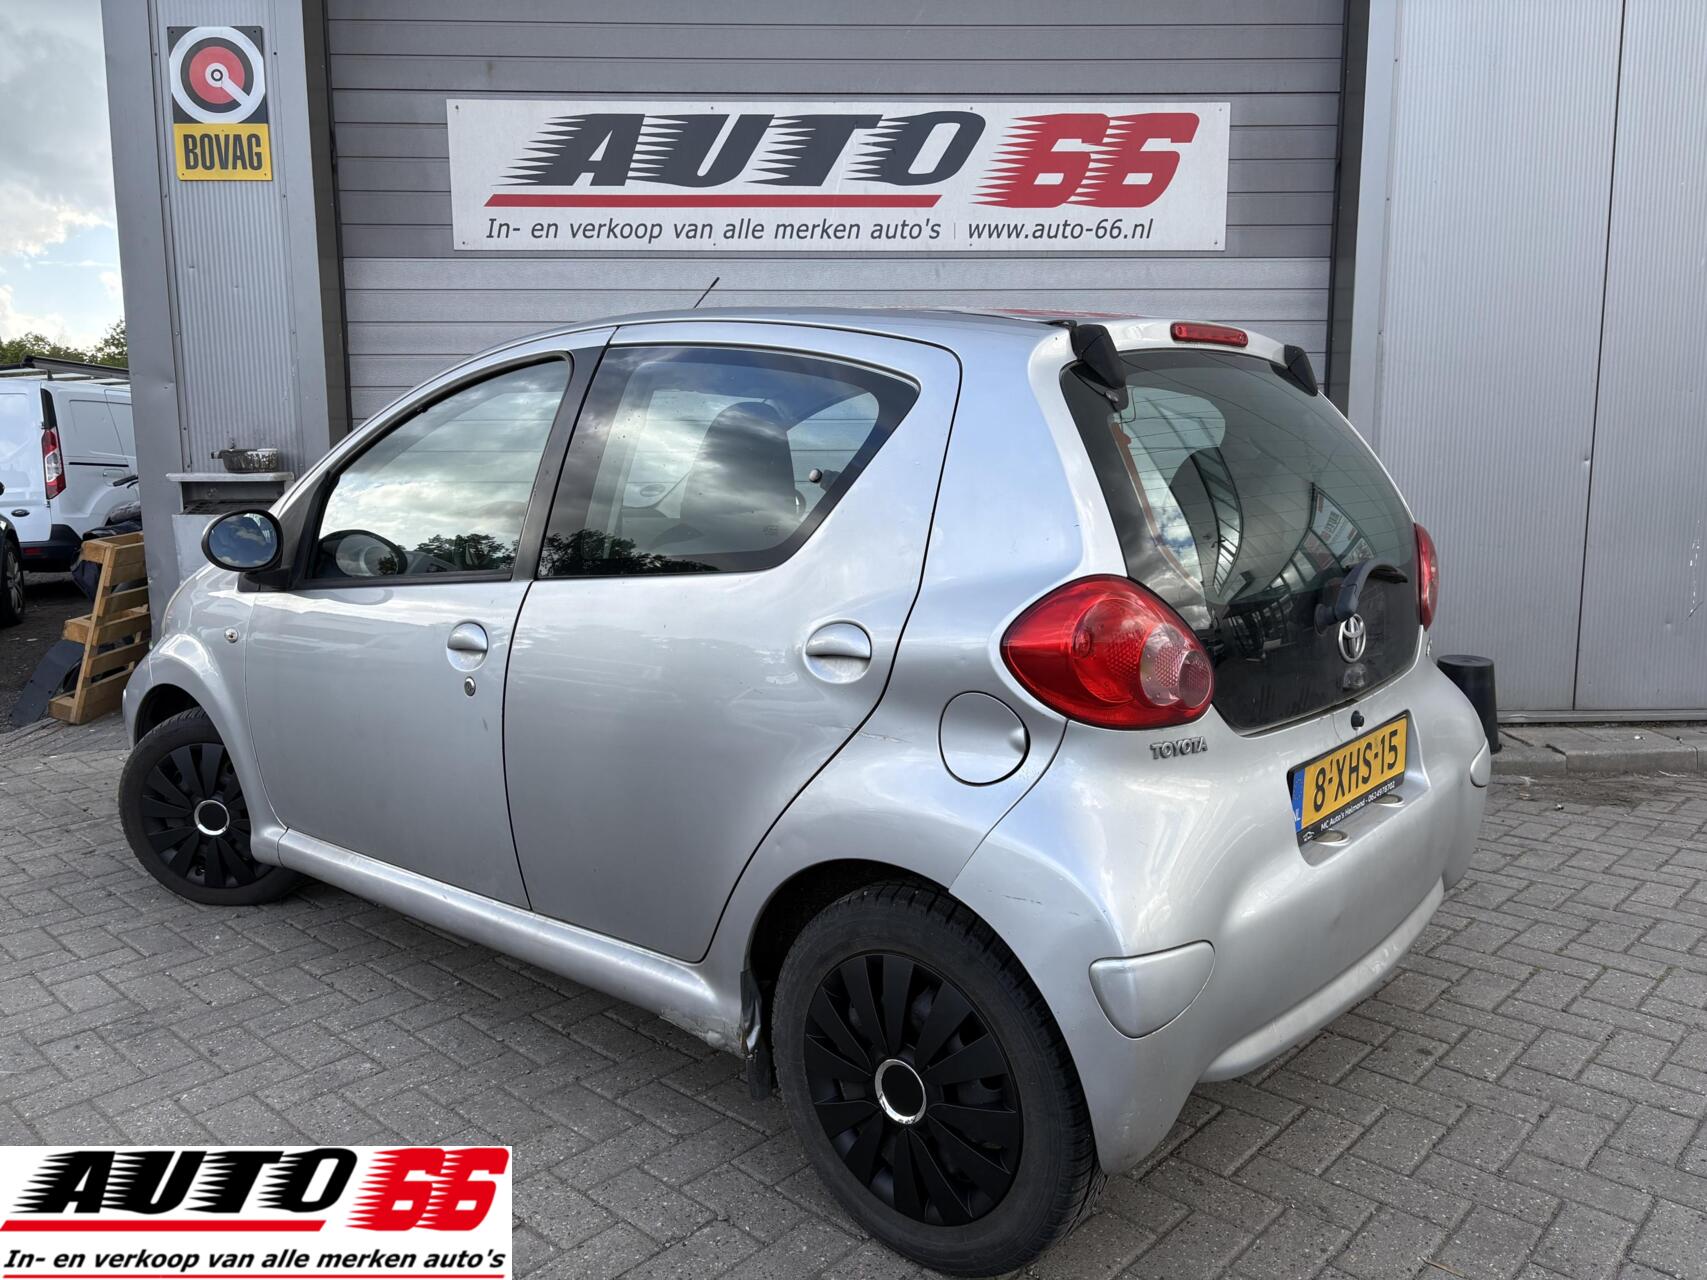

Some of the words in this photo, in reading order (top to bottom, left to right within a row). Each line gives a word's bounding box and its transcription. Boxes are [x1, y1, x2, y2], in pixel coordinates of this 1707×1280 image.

[183, 133, 263, 171] BOVAG
[491, 110, 986, 187] AUTO
[968, 112, 1200, 208] 66
[486, 218, 521, 239] In-
[531, 222, 559, 239] en
[569, 218, 663, 244] verkoop
[673, 222, 713, 239] van
[723, 218, 765, 239] alle
[774, 218, 861, 239] merken
[870, 218, 941, 239] auto's
[968, 218, 1154, 239] www.auto-66.nl
[1150, 736, 1208, 759] TOYOTA
